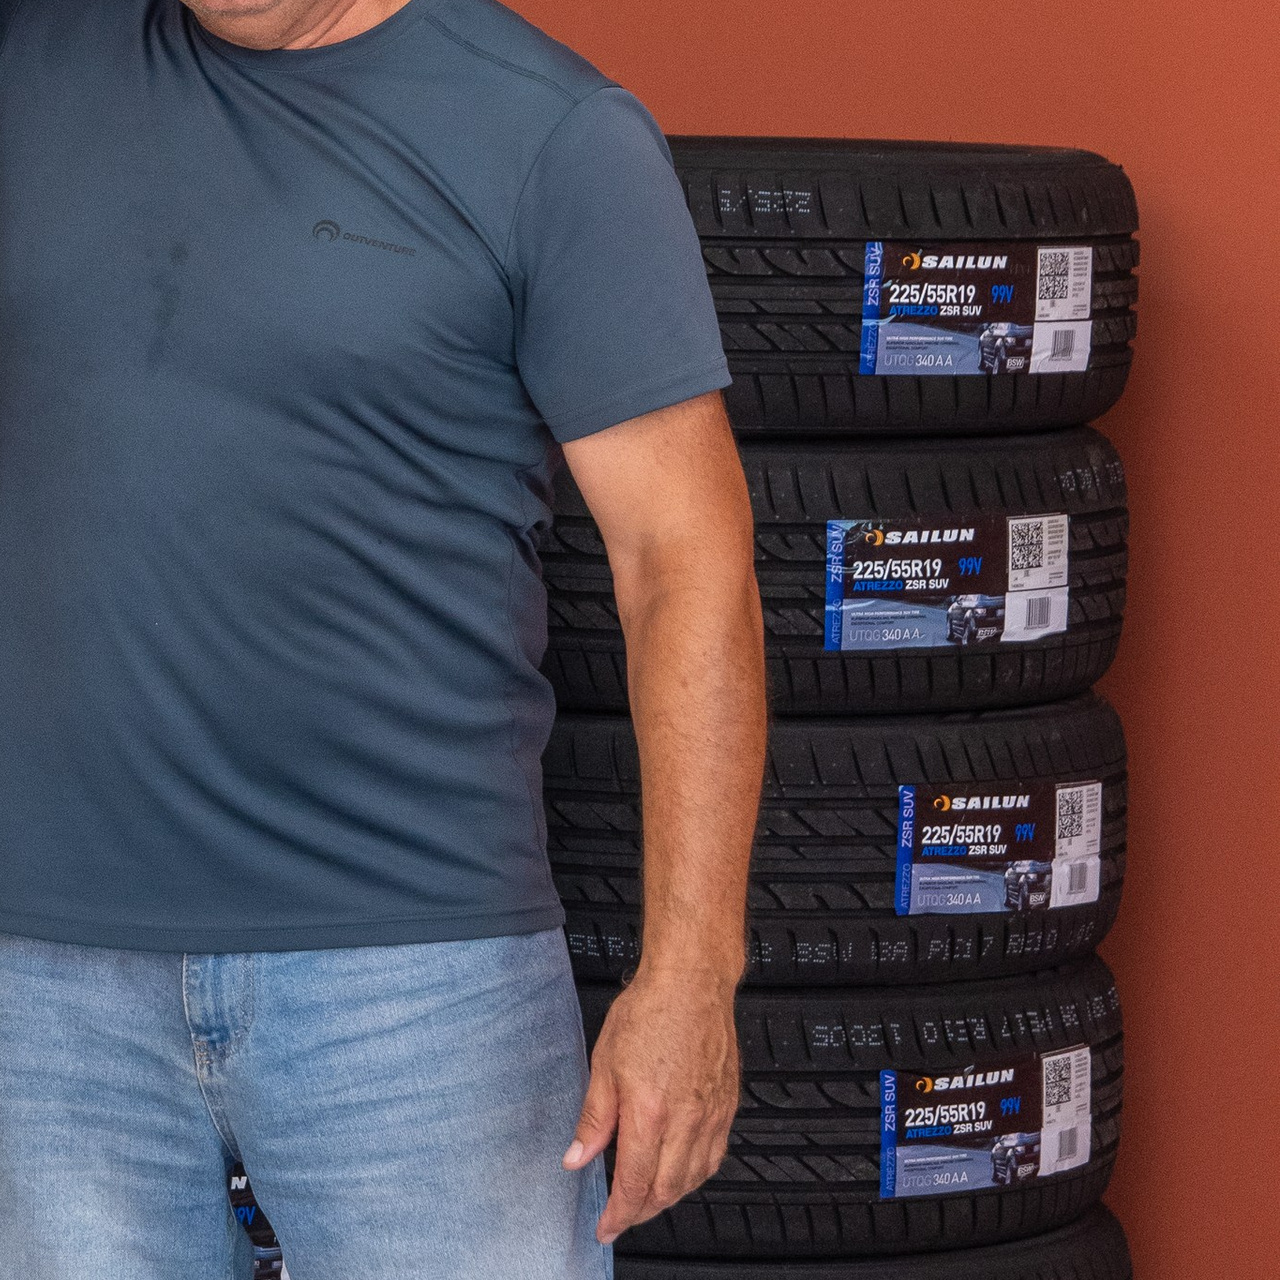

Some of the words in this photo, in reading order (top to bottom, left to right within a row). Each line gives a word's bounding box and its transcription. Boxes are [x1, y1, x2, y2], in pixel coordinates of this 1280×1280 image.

[922, 256, 1007, 269] SAILUN
[889, 284, 975, 303] 225/55R19
[991, 285, 1013, 303] 99V
[889, 306, 937, 315] ATREZZO
[940, 306, 960, 315] ZSR
[962, 306, 982, 315] SUV
[885, 529, 974, 543] SAILUN
[853, 559, 942, 579] 225/55R19
[959, 557, 982, 575] 99V
[854, 581, 903, 591] ATREZZO
[906, 580, 926, 589] ZSR
[929, 579, 949, 588] SUV
[903, 791, 913, 817] SUV
[951, 795, 1030, 809] SAILUN
[902, 822, 912, 847] ZSR
[922, 825, 1001, 845] 225/55R19
[1016, 824, 1035, 841] 99V
[922, 846, 966, 855] ATREZZO
[969, 846, 987, 855] ZSR
[989, 845, 1007, 854] SUV
[885, 1075, 896, 1101] SUV
[934, 1069, 1014, 1090] SAILUN
[885, 1105, 895, 1131] ZSR
[905, 1102, 985, 1126] 225/55R19
[1000, 1097, 1020, 1116] 99V
[906, 1126, 951, 1139] ATREZZO
[954, 1123, 972, 1134] ZSR
[975, 1121, 992, 1131] SUV
